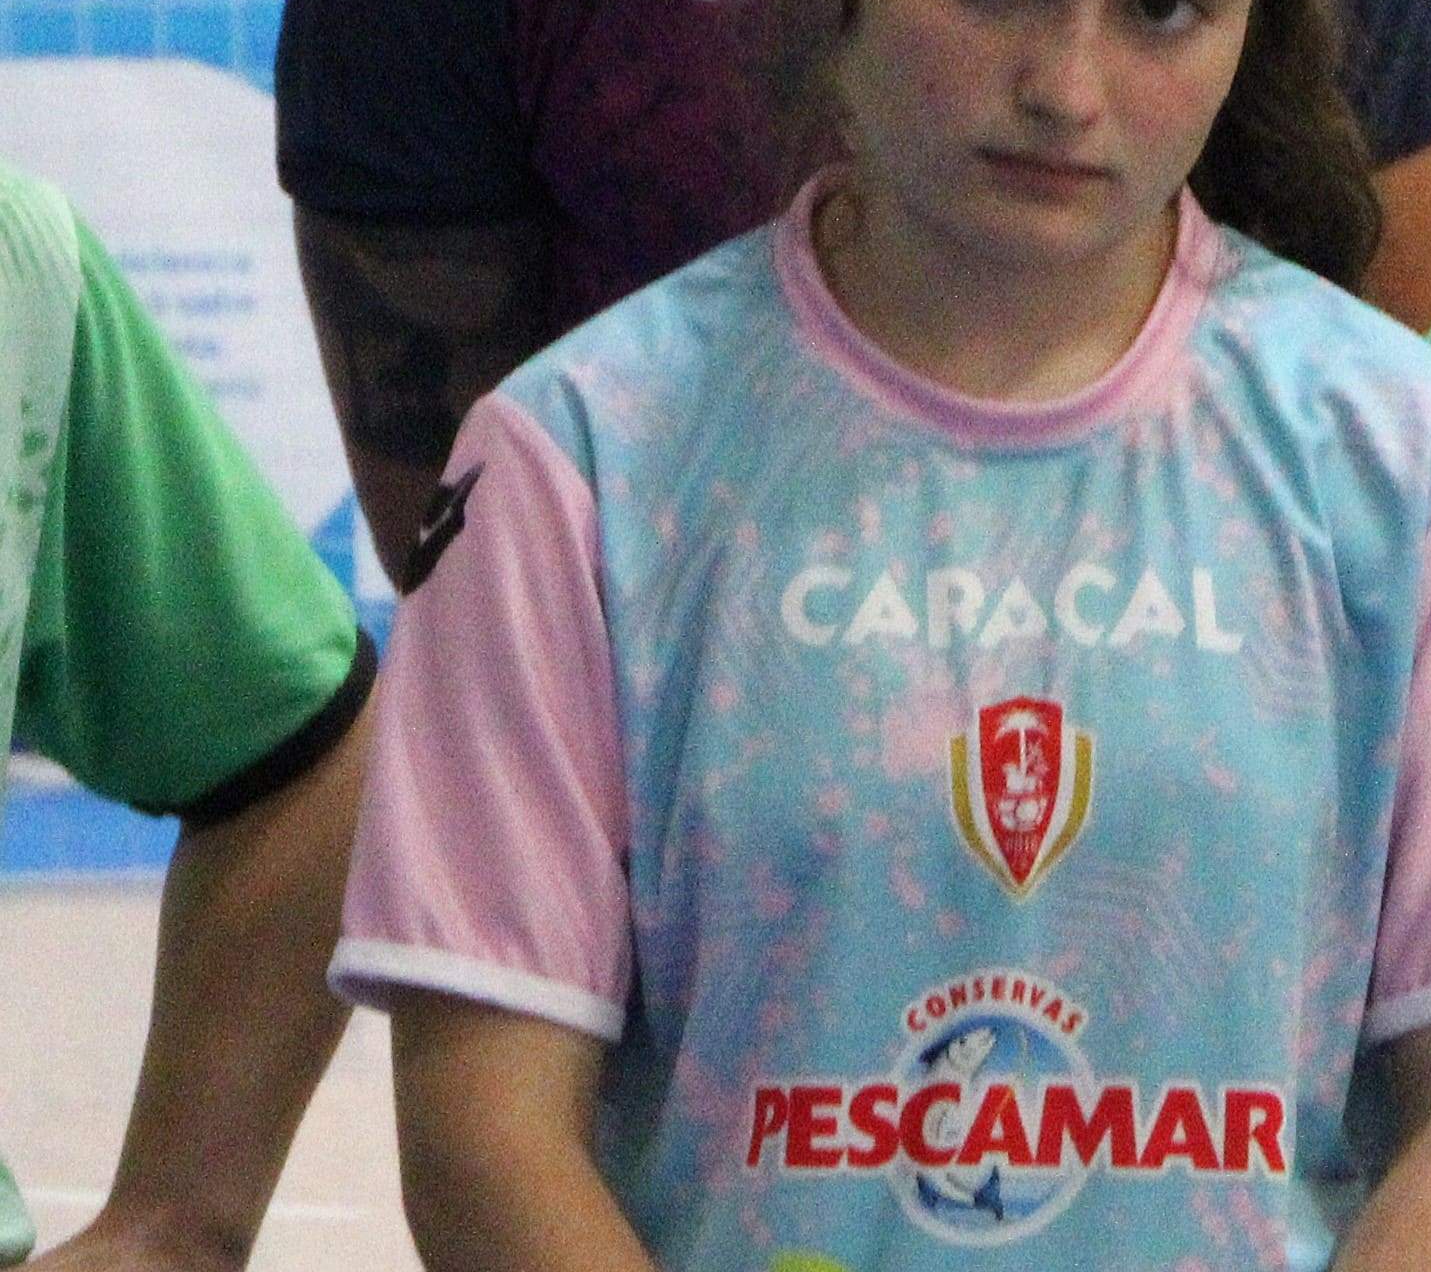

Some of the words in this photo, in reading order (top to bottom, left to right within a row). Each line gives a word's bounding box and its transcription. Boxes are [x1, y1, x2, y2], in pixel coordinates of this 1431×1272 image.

[780, 565, 1243, 655] CARACAL
[906, 974, 1085, 1033] CONSERVAS
[746, 1084, 1286, 1173] PESCAMAR
